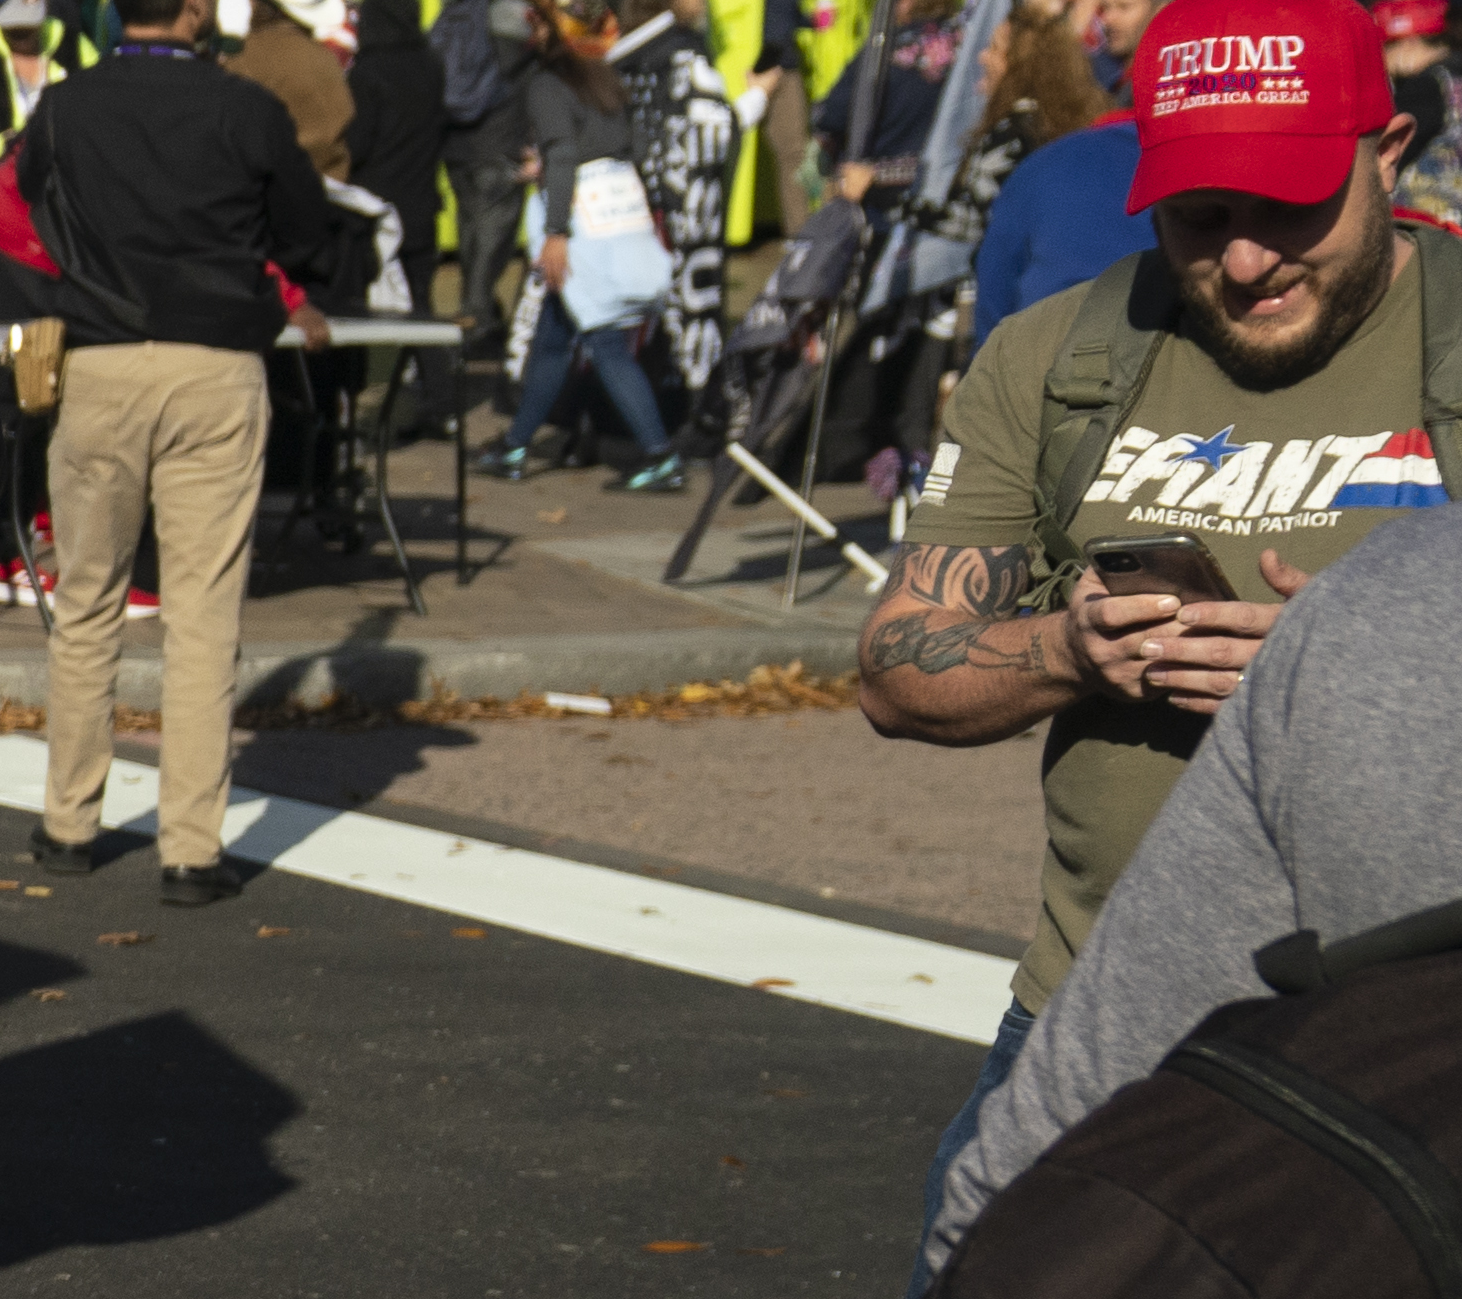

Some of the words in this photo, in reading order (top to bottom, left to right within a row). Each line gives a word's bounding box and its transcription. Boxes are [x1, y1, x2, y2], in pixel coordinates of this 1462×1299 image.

[1157, 35, 1305, 82] TRUMP
[1189, 72, 1256, 96] 2020
[1180, 91, 1253, 111] AMERICA
[1256, 90, 1311, 105] GREAT
[1084, 425, 1393, 518] EFIANT
[1126, 506, 1252, 536] AMERICAN
[1256, 510, 1343, 534] PATRIOT
